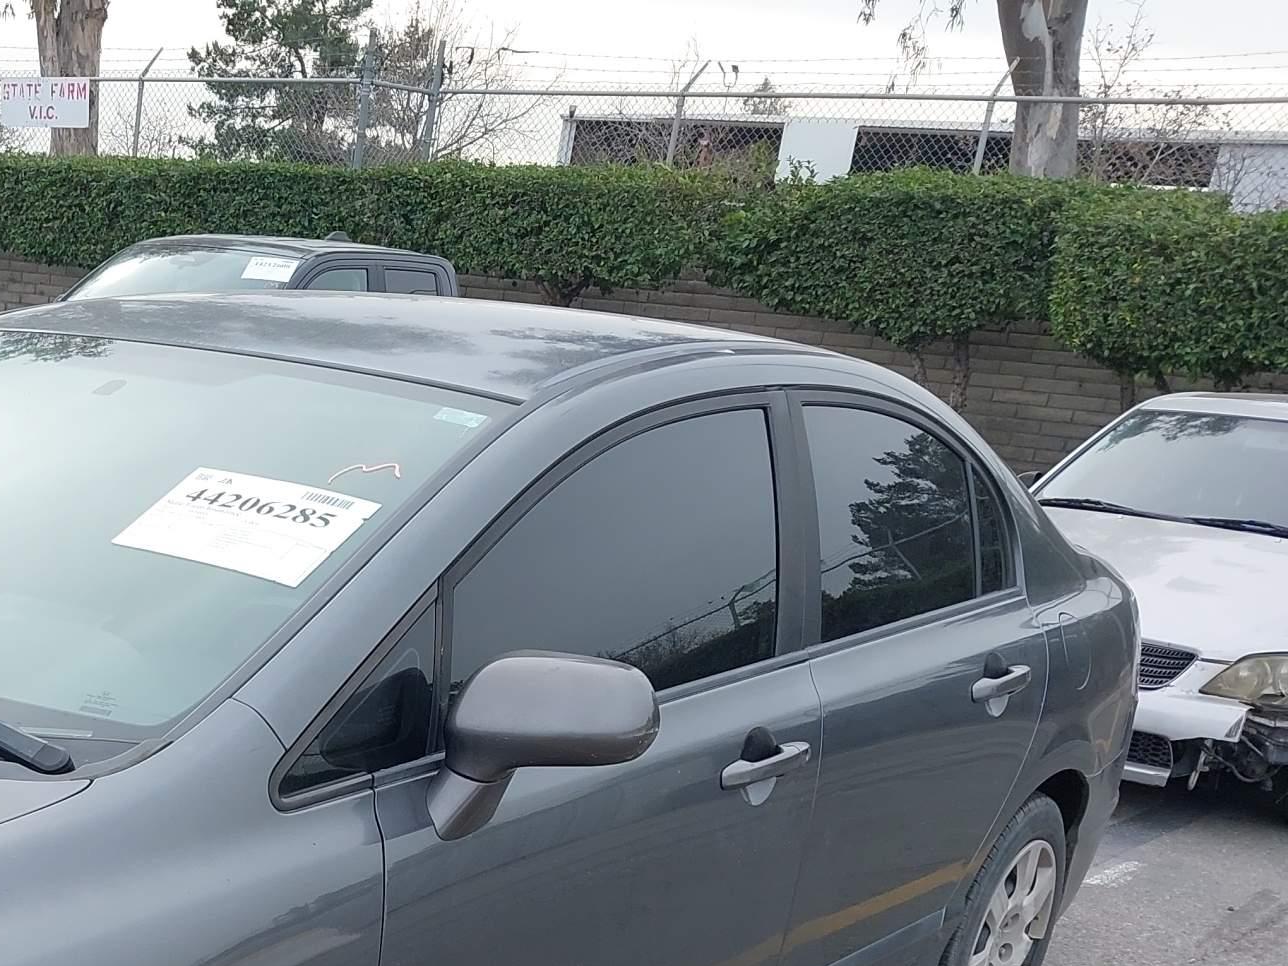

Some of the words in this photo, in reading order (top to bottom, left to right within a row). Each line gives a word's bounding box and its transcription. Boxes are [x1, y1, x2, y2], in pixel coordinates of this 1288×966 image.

[3, 83, 42, 101] STATE
[50, 82, 87, 101] FARM
[28, 105, 58, 120] V.I.C.
[185, 487, 337, 529] 44206285
